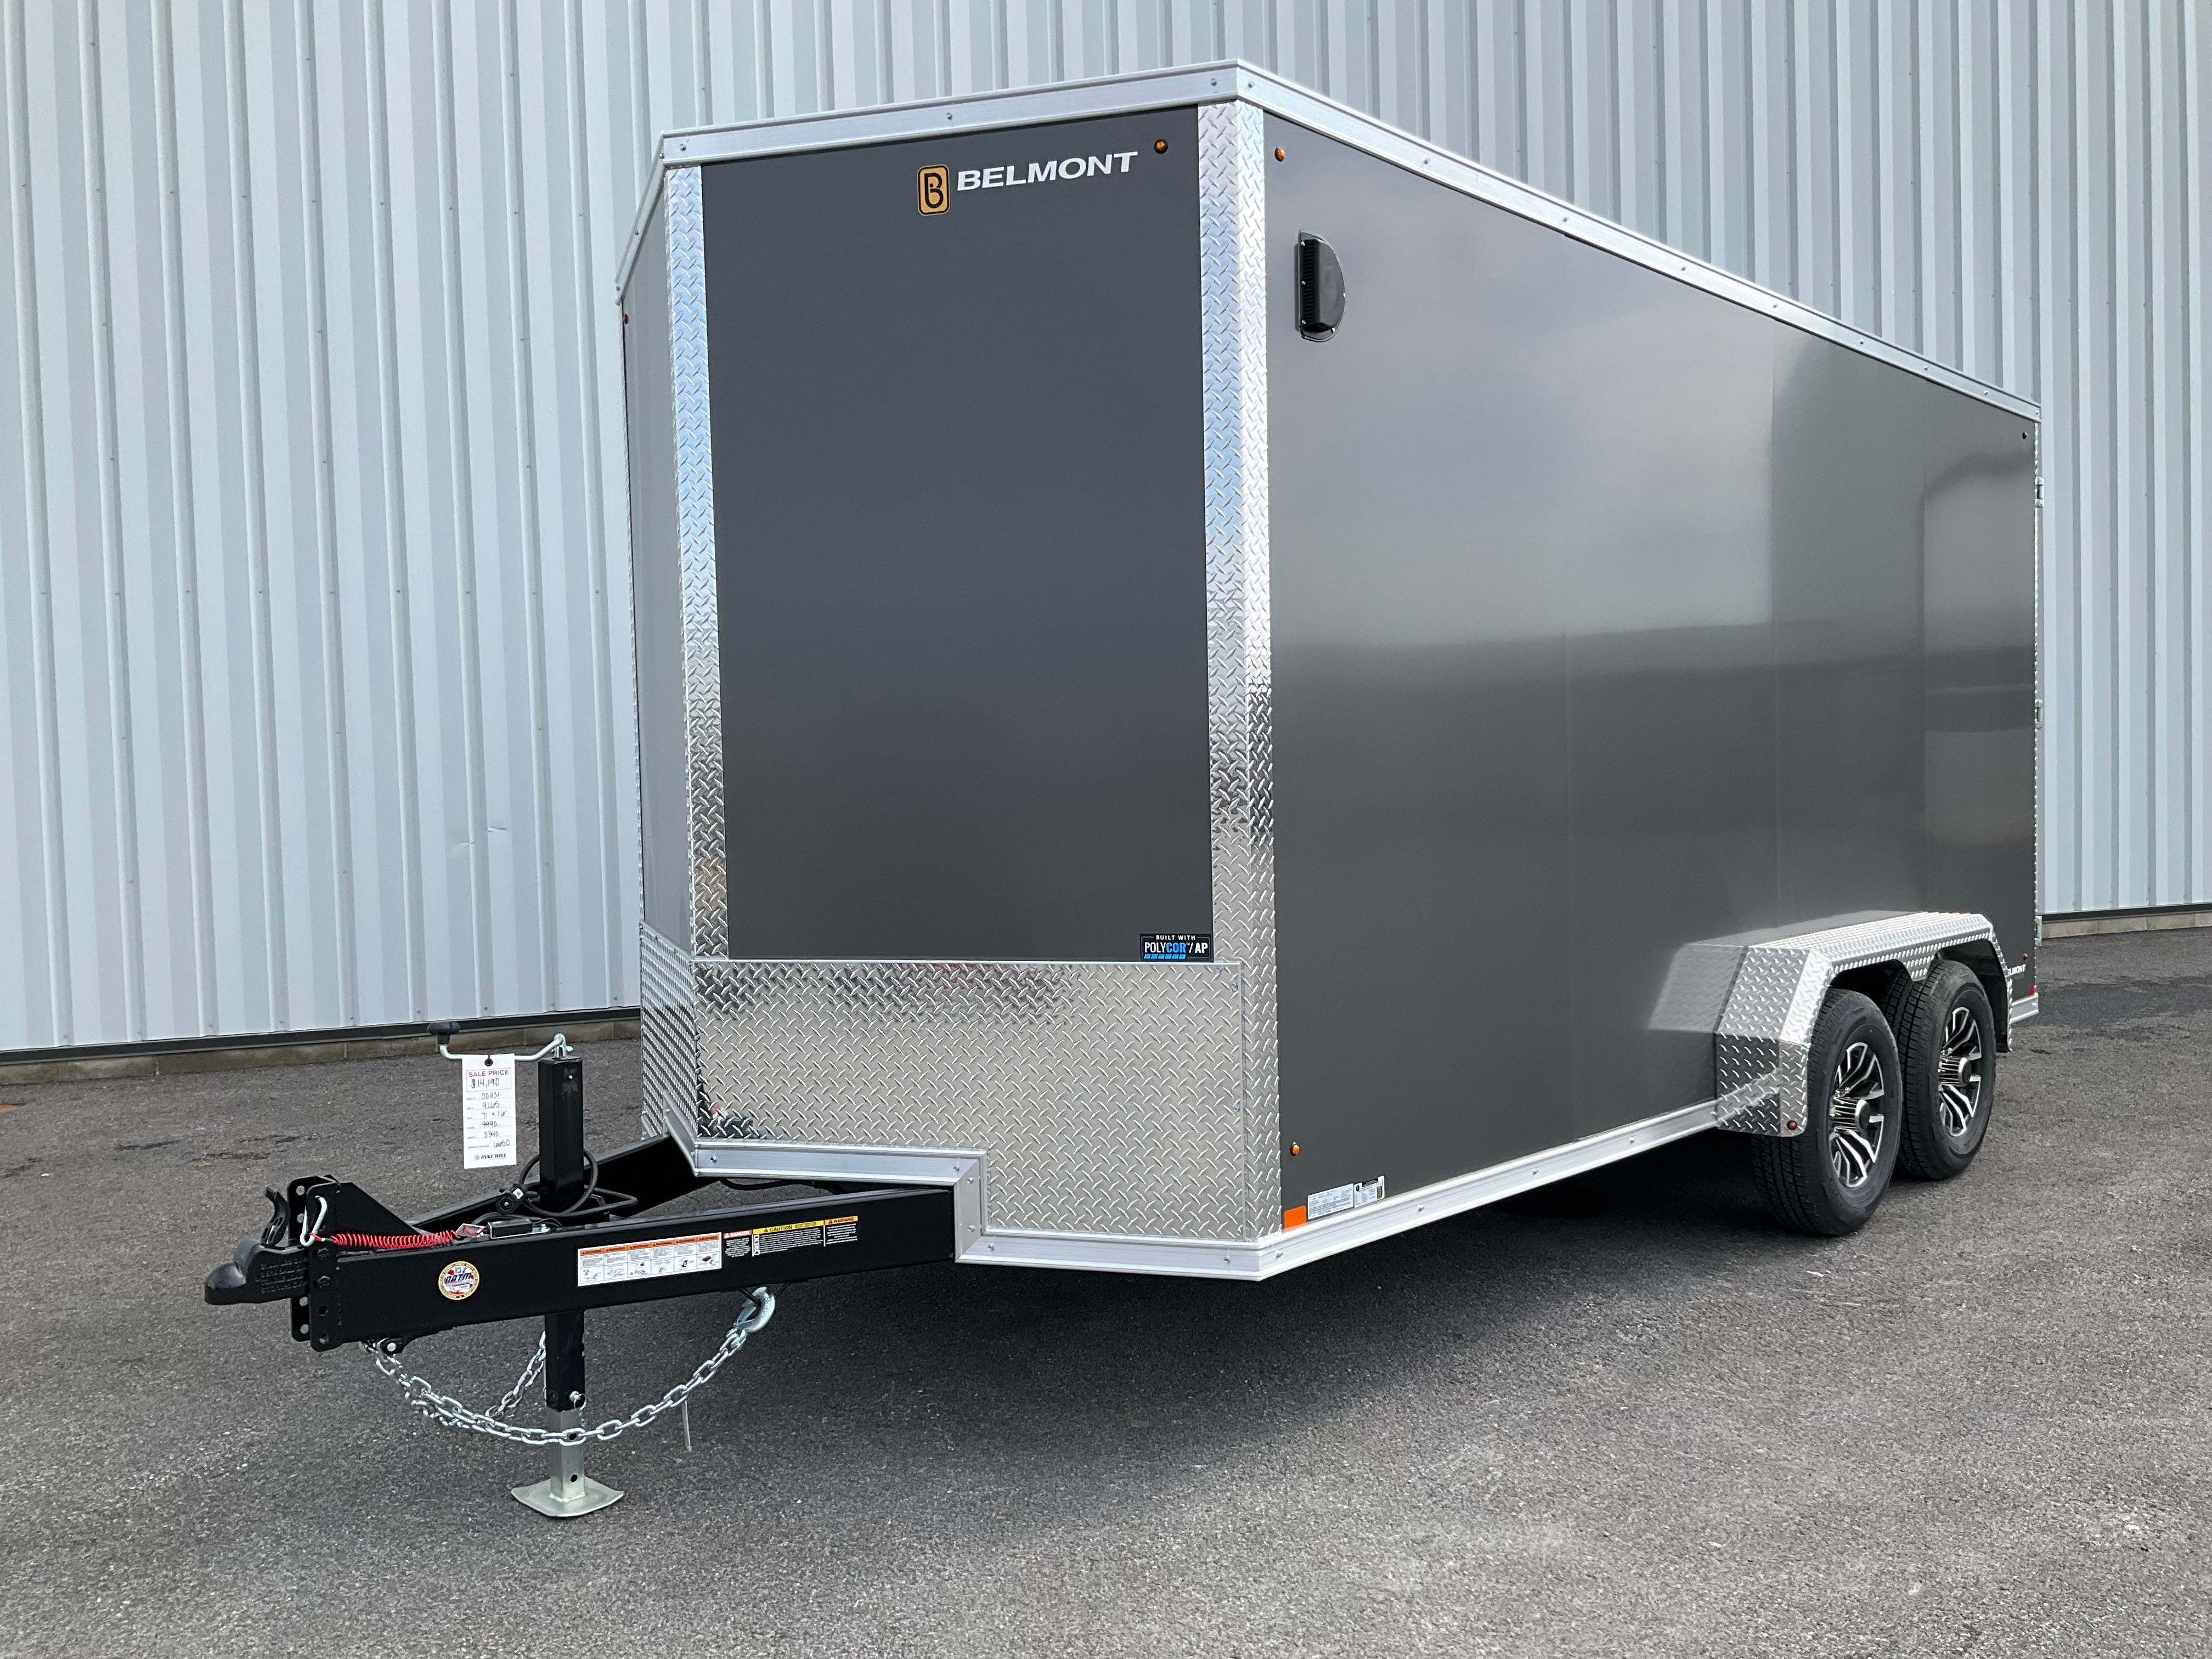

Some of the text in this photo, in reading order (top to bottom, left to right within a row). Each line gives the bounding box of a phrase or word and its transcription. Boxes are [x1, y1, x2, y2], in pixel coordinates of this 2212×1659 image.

[957, 151, 1138, 191] BELMONT
[471, 1077, 500, 1089] $14,190
[481, 1091, 500, 1100] 00931
